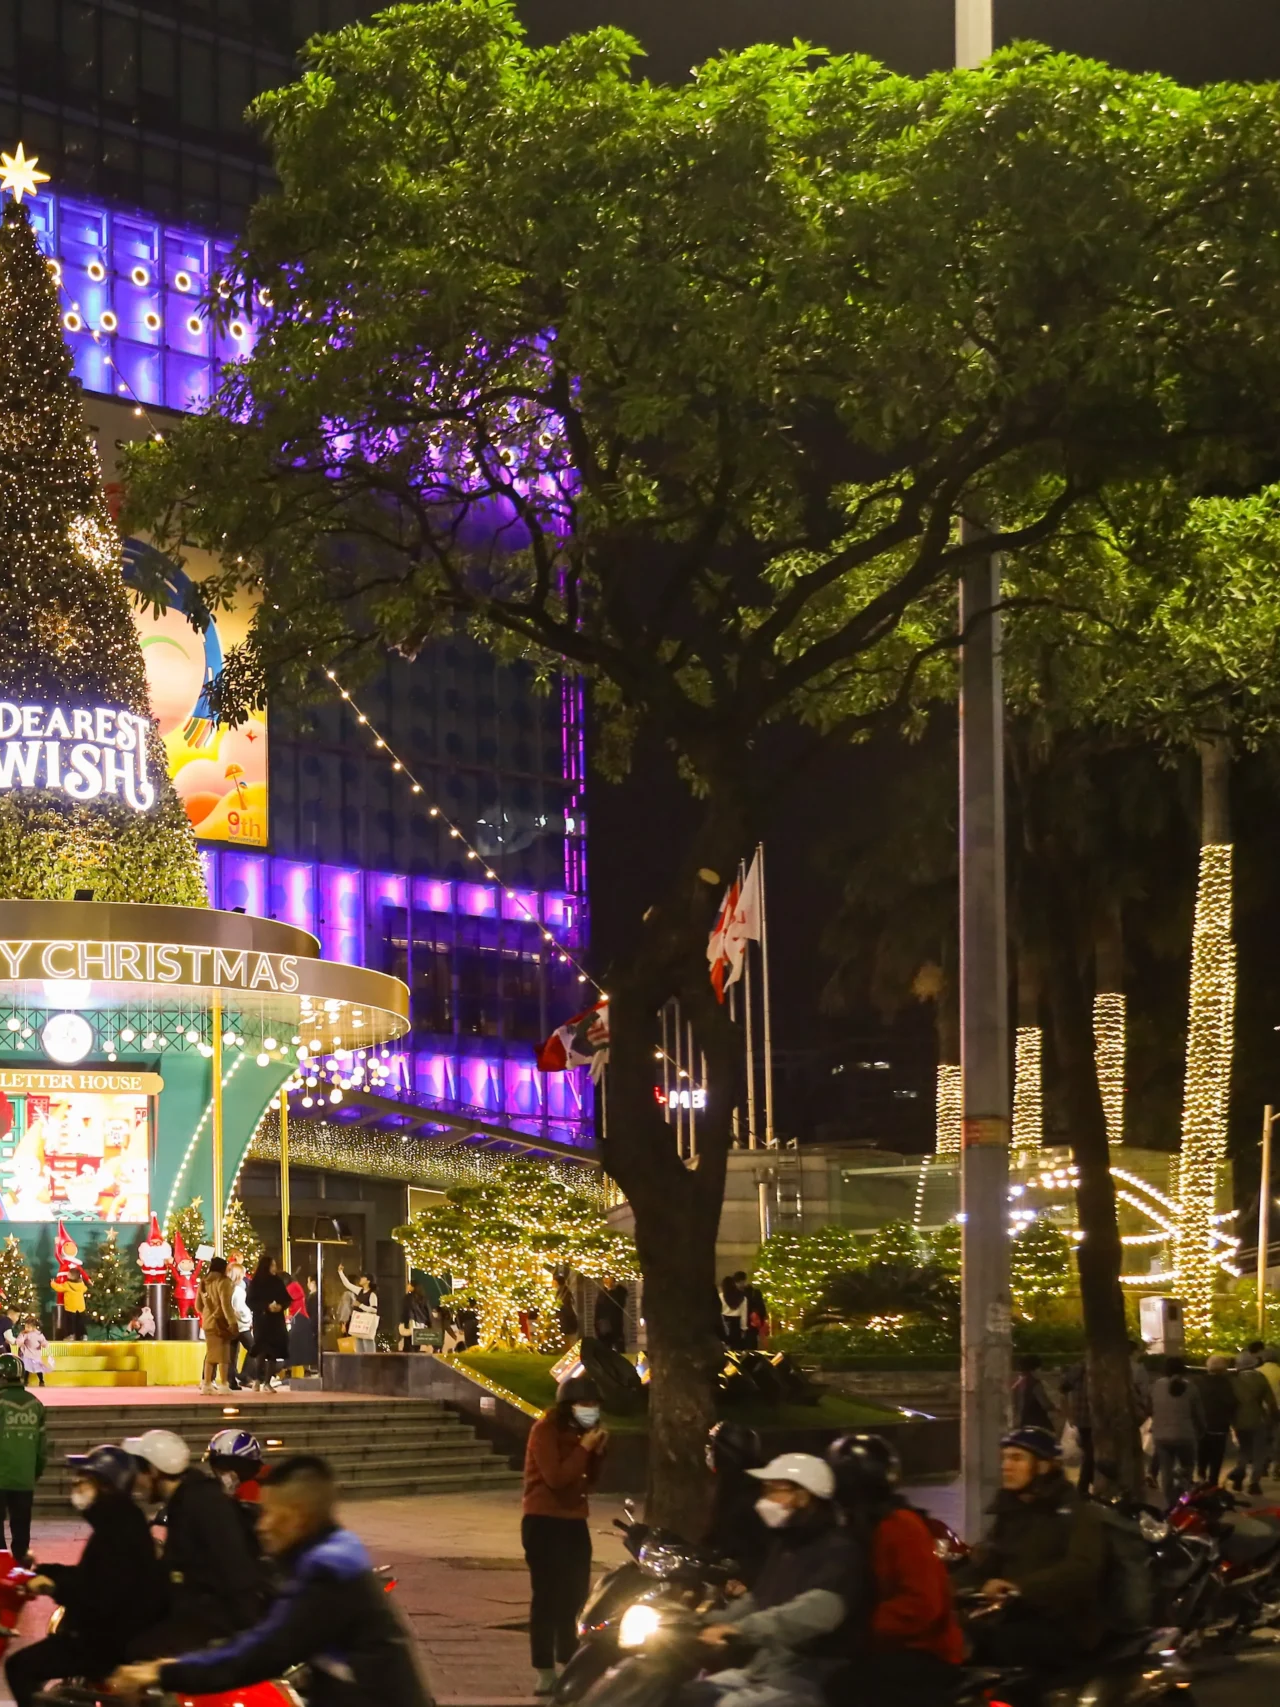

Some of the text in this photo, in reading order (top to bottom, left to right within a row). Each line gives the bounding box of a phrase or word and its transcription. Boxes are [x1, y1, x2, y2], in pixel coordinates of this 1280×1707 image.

[42, 942, 299, 992] CHRISTMAS
[0, 1073, 142, 1091] LETTER HOUSE
[5, 1408, 38, 1425] Grab
